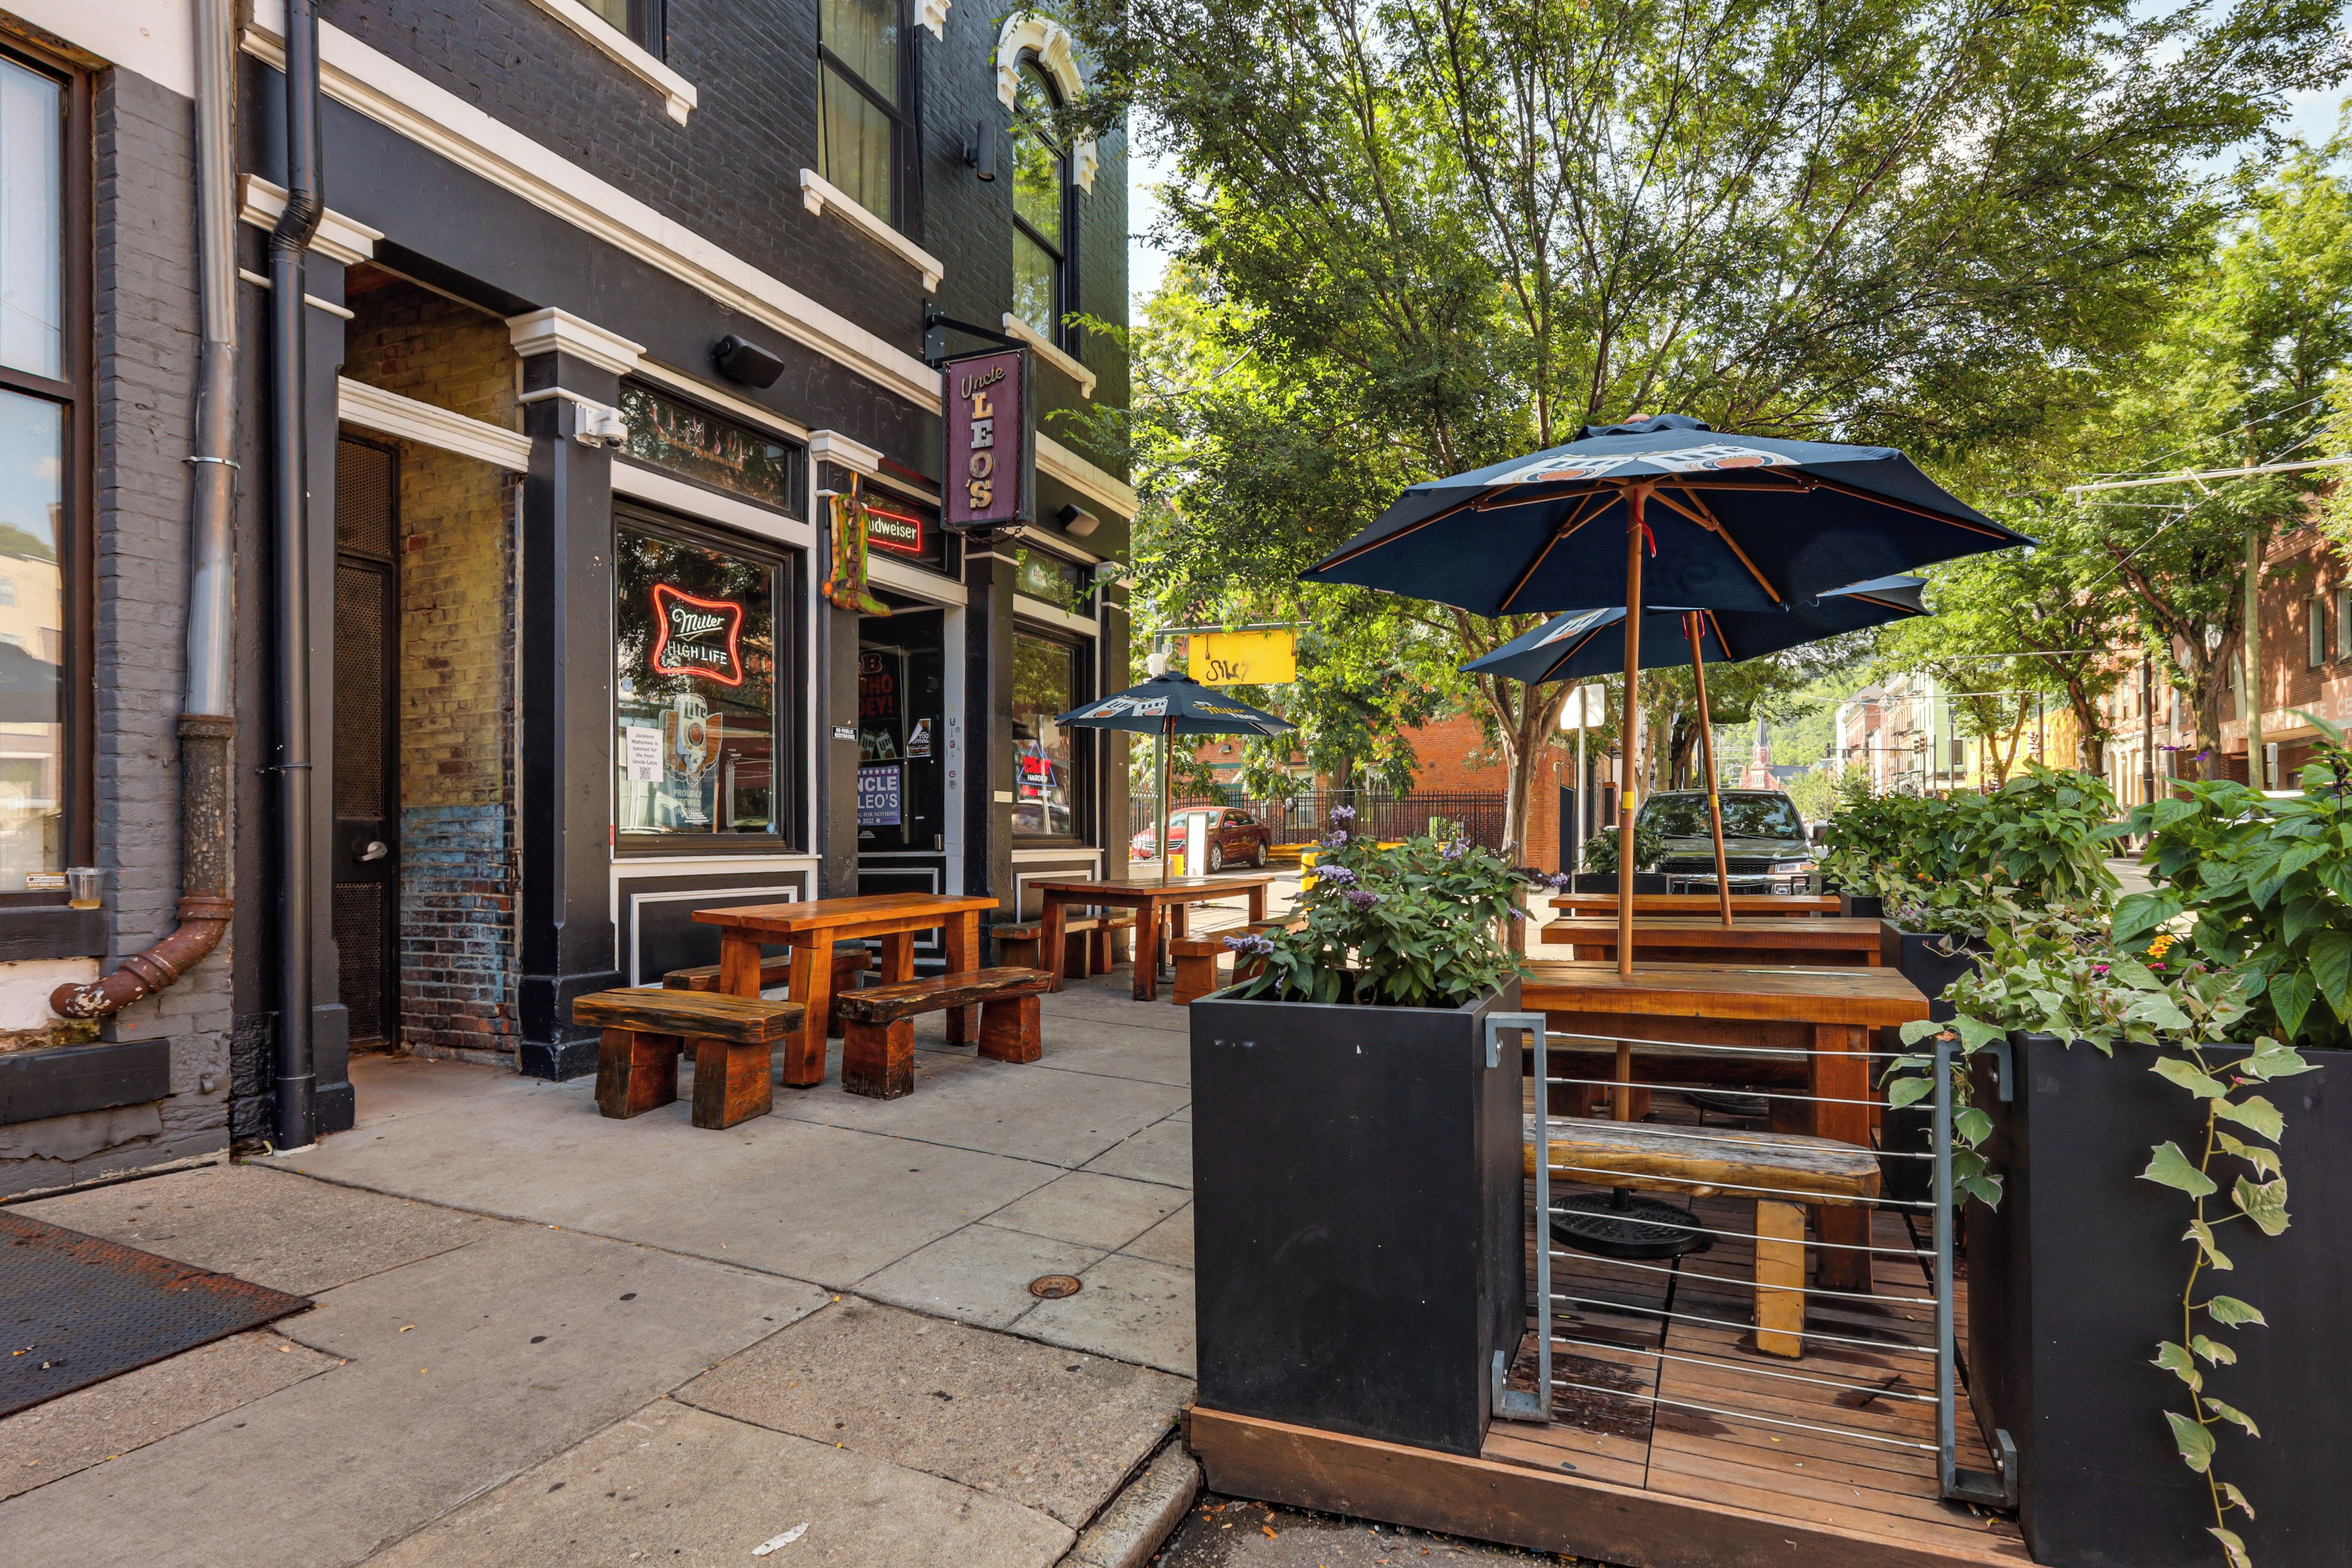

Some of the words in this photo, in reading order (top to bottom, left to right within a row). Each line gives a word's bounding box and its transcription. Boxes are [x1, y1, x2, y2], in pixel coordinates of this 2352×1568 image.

[961, 363, 1006, 398] Uncle
[965, 391, 995, 510] LEO'S
[868, 517, 917, 540] udweiser
[671, 608, 725, 634] Miller
[667, 640, 699, 659] HIGH
[701, 646, 727, 665] LIFE
[684, 701, 706, 720] Lite
[1192, 703, 1246, 715] Miller
[1227, 712, 1264, 722] TIME
[858, 776, 897, 792] NCLE
[1027, 774, 1048, 782] HARDER
[674, 789, 703, 798] PROUDLY
[858, 793, 898, 809] LEO'S
